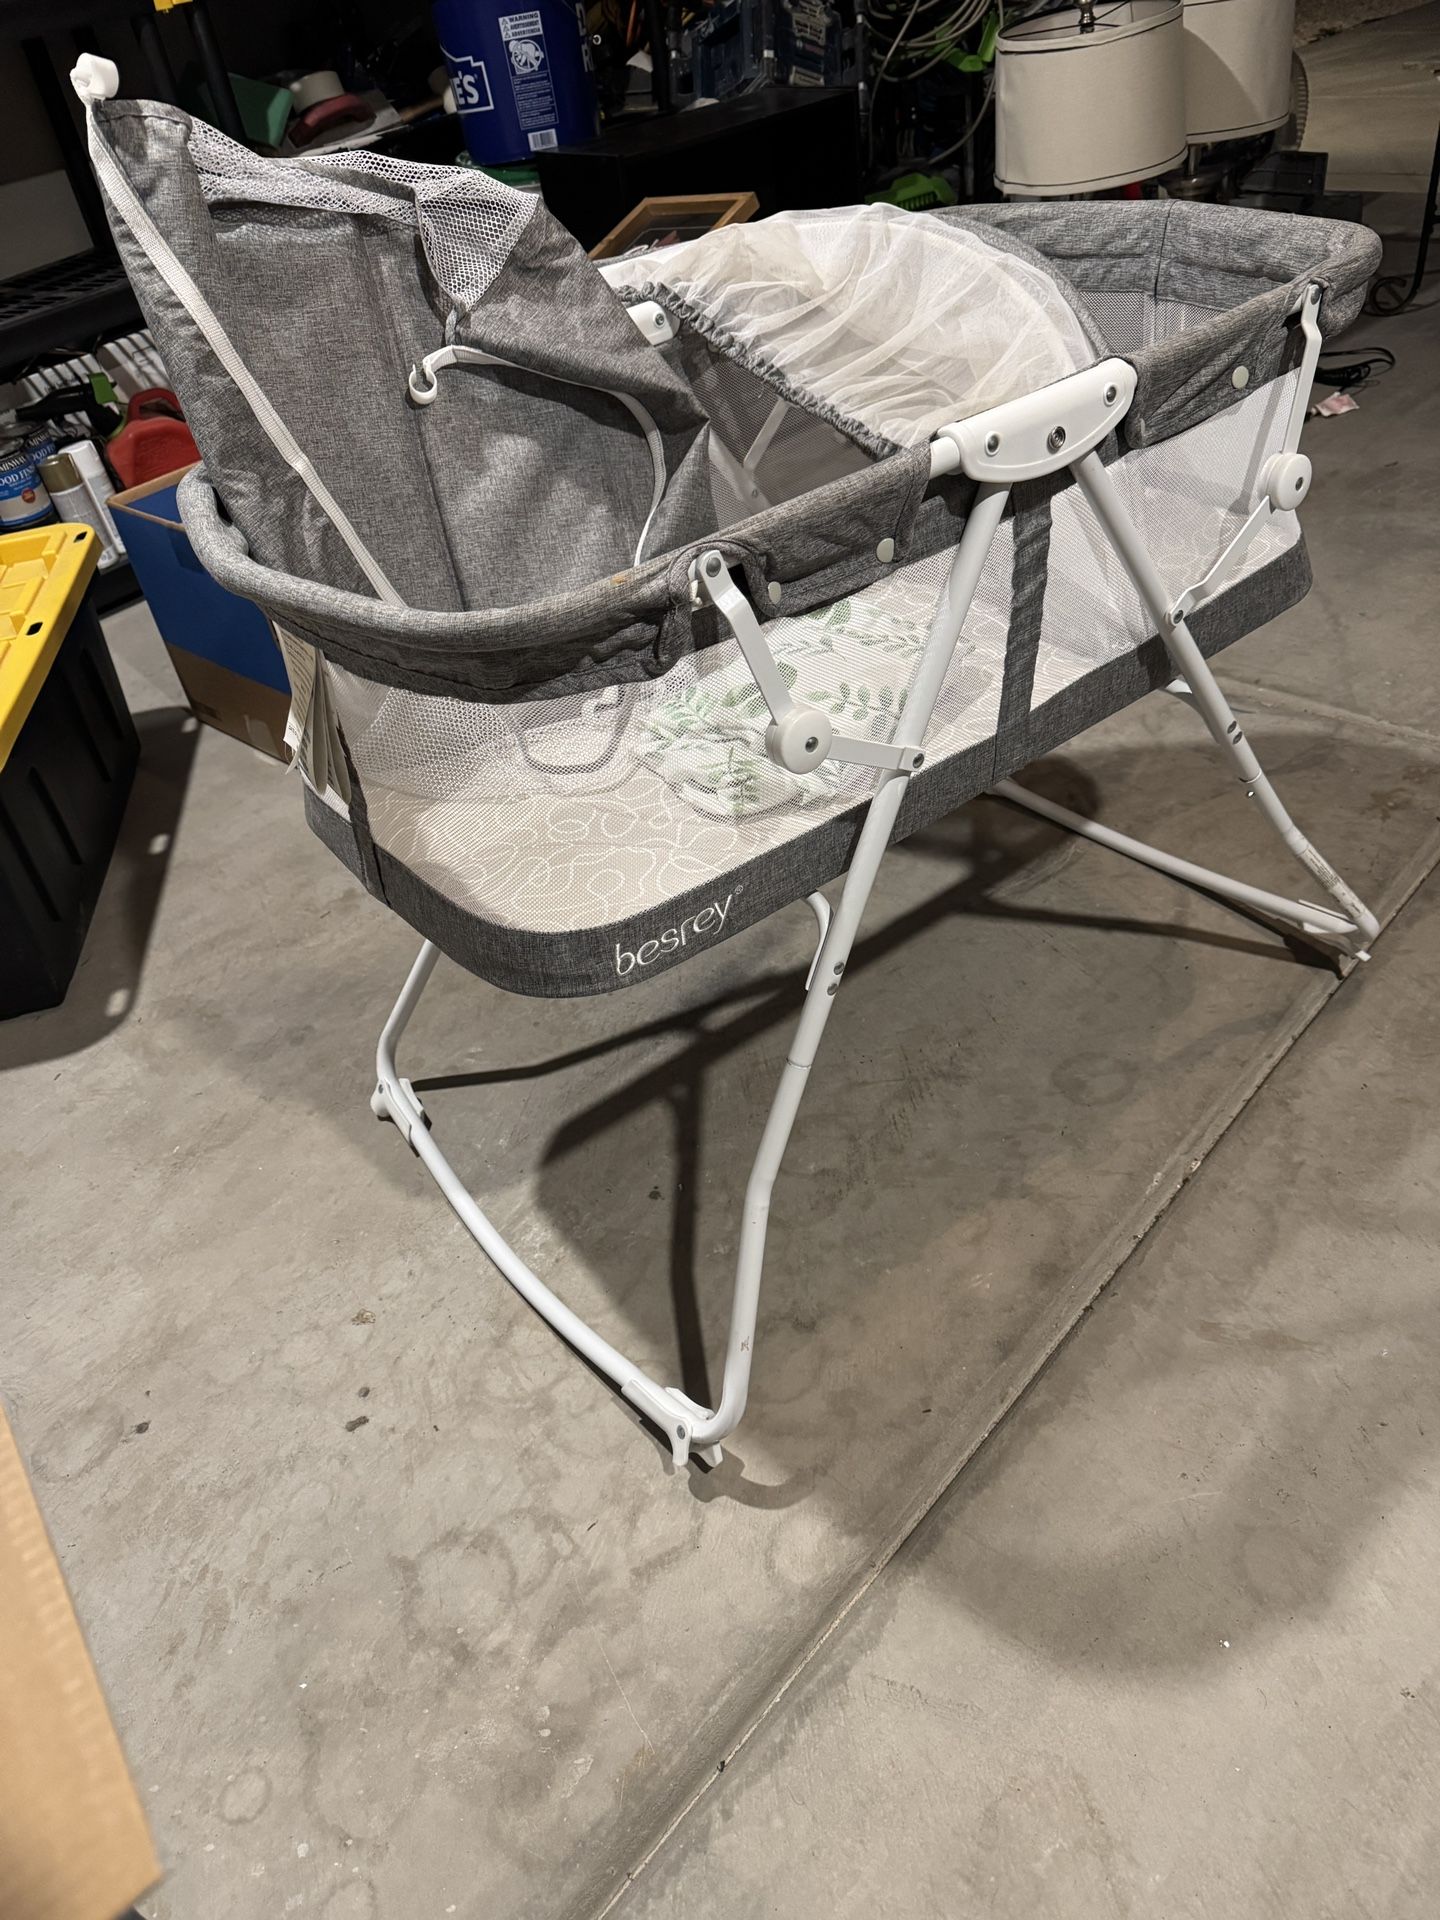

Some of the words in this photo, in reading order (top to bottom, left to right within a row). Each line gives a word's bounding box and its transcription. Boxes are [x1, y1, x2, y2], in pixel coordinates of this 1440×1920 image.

[508, 12, 539, 23] WARNING
[0, 473, 19, 487] OOD
[616, 894, 732, 975] besrey
